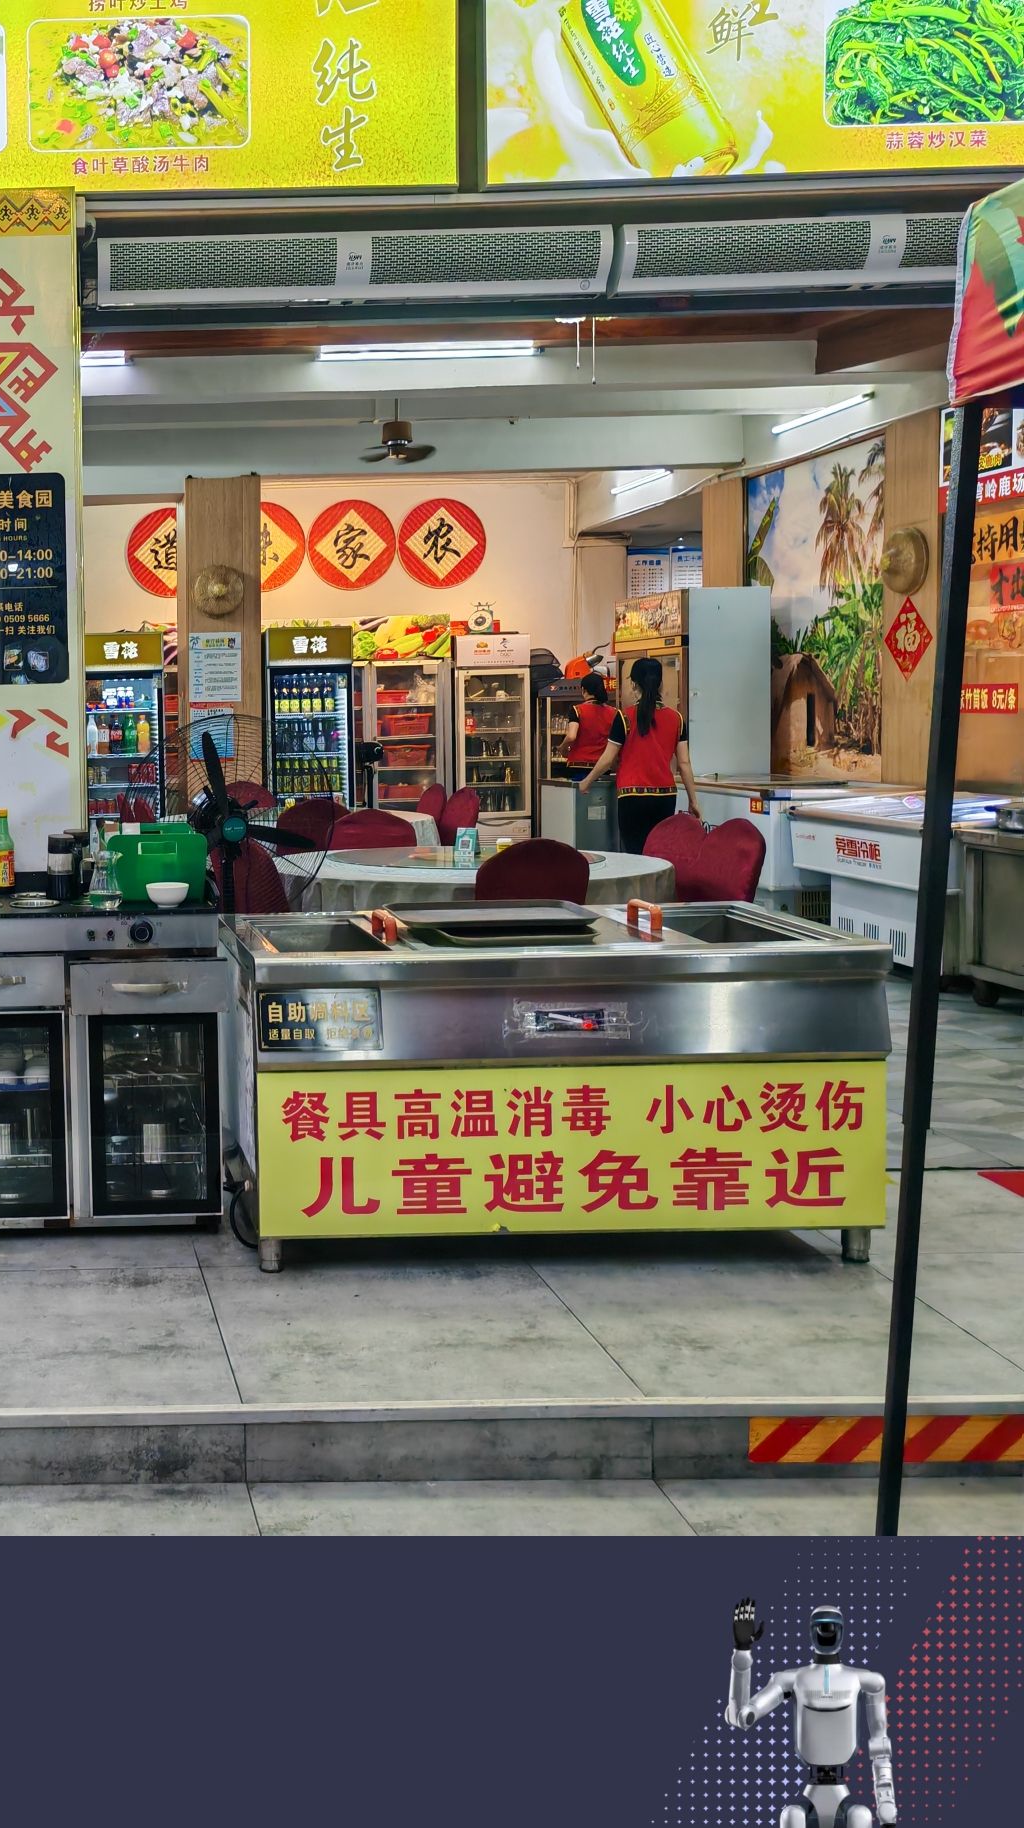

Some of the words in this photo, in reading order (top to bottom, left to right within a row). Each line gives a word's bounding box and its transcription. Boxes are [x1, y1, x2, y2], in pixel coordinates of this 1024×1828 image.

[885, 129, 988, 150] 蒜蓉炒汉菜
[71, 155, 210, 176] 食叶草酸汤牛肉
[3, 534, 28, 542] HOURS
[4, 615, 26, 623] 0509
[17, 625, 56, 635] 关注我们
[895, 612, 921, 653] 福
[269, 1028, 315, 1040] 适量自取
[281, 1085, 612, 1143] 餐具高温消毒
[645, 1080, 866, 1134] 小心烫伤
[301, 1146, 847, 1218] 儿童避免靠近
